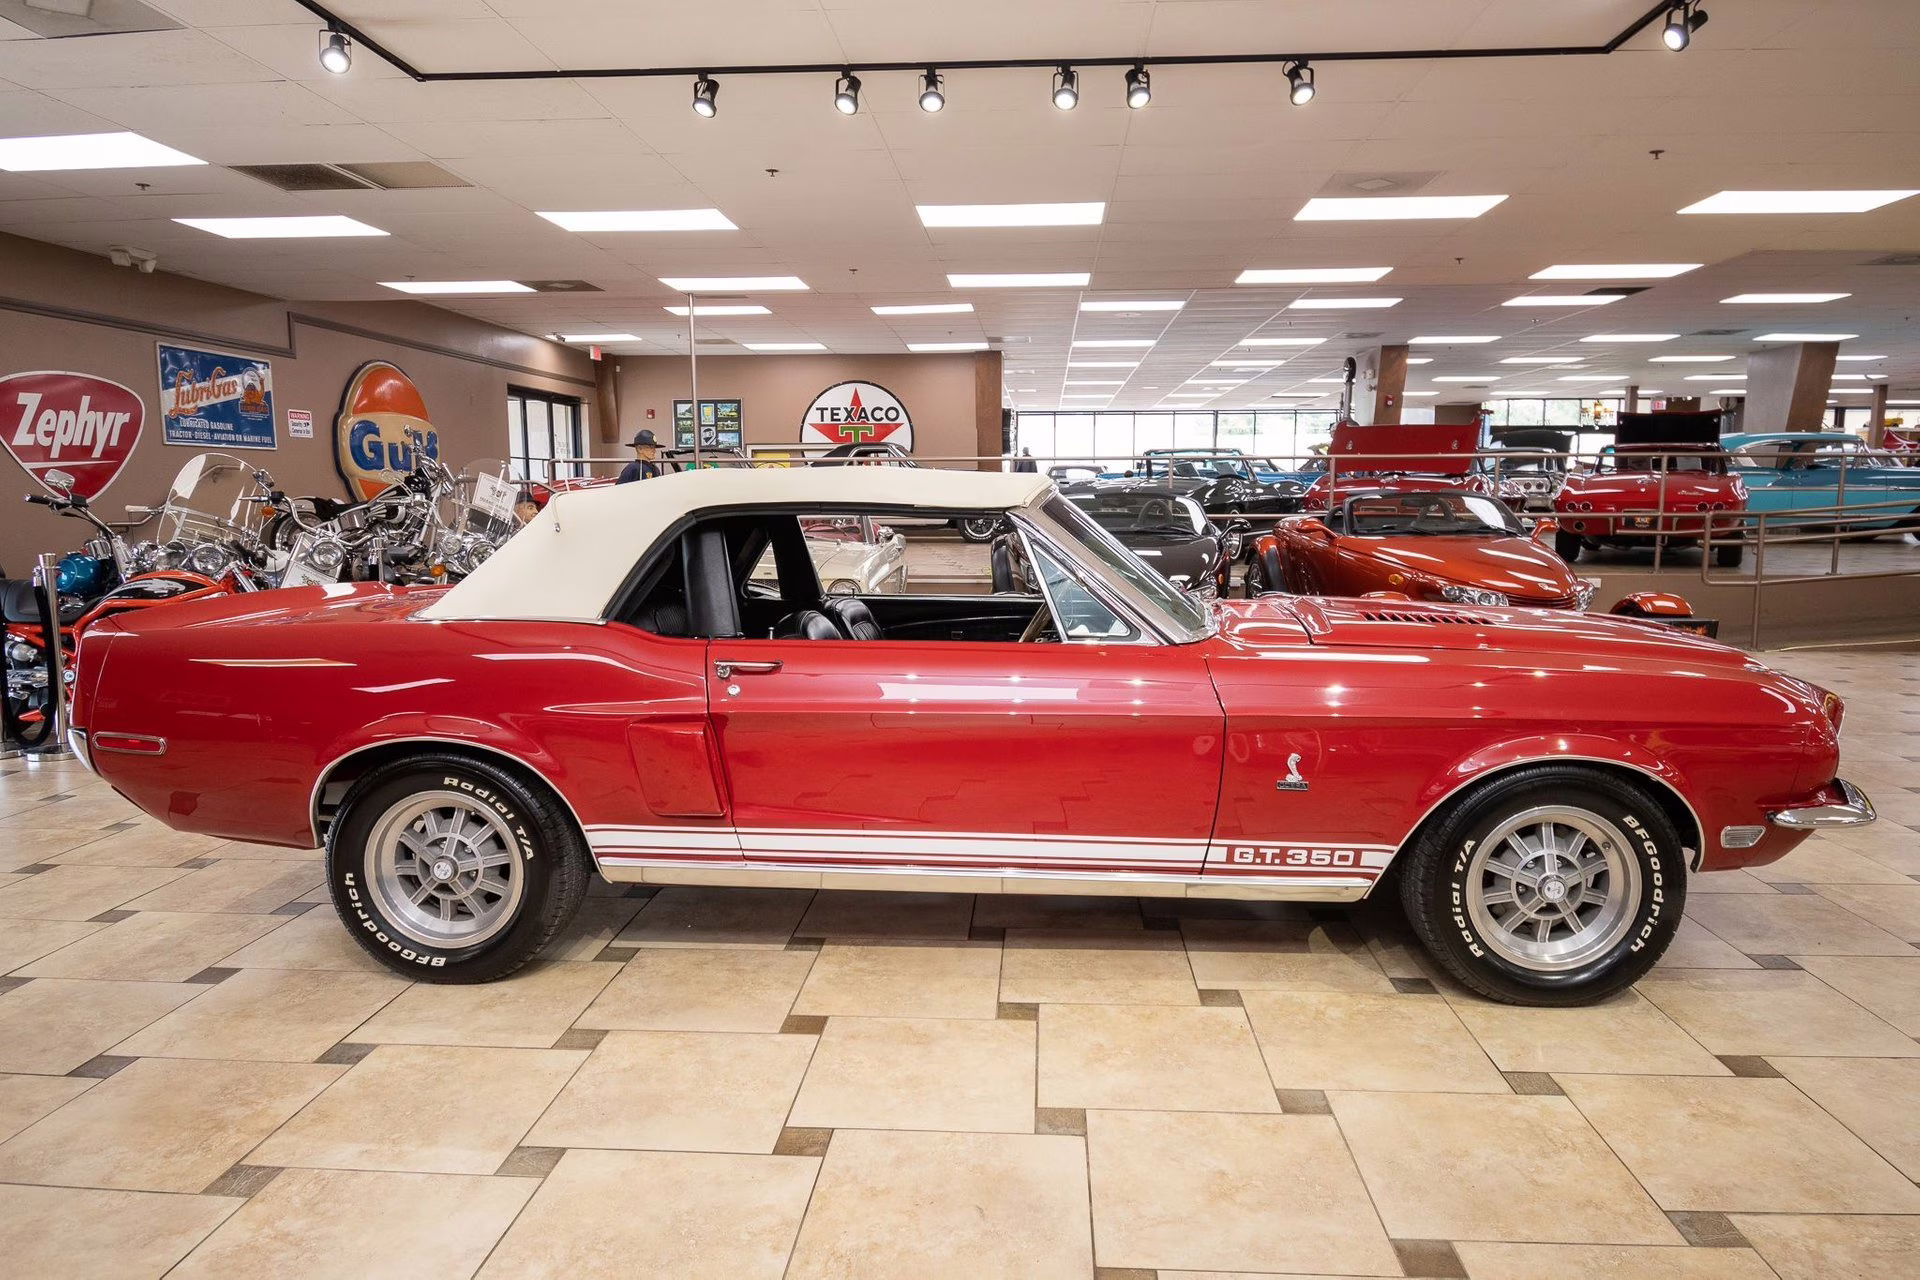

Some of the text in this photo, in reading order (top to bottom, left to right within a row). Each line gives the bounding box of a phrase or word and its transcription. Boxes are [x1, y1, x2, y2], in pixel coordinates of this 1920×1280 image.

[12, 392, 130, 458] Zephyr
[169, 429, 194, 440] TRACTOR
[195, 432, 212, 440] DIESEL
[213, 433, 236, 442] AVIATION
[236, 434, 243, 442] OR
[243, 435, 261, 443] MARINE
[180, 419, 234, 431] LUBRICATED GASOLINE
[815, 407, 900, 422] TEXACO
[443, 776, 535, 861] Radial T/A
[344, 872, 447, 967] BFGoodrich
[1451, 838, 1484, 958] Radial T/A
[1622, 814, 1664, 952] BFGoodrich
